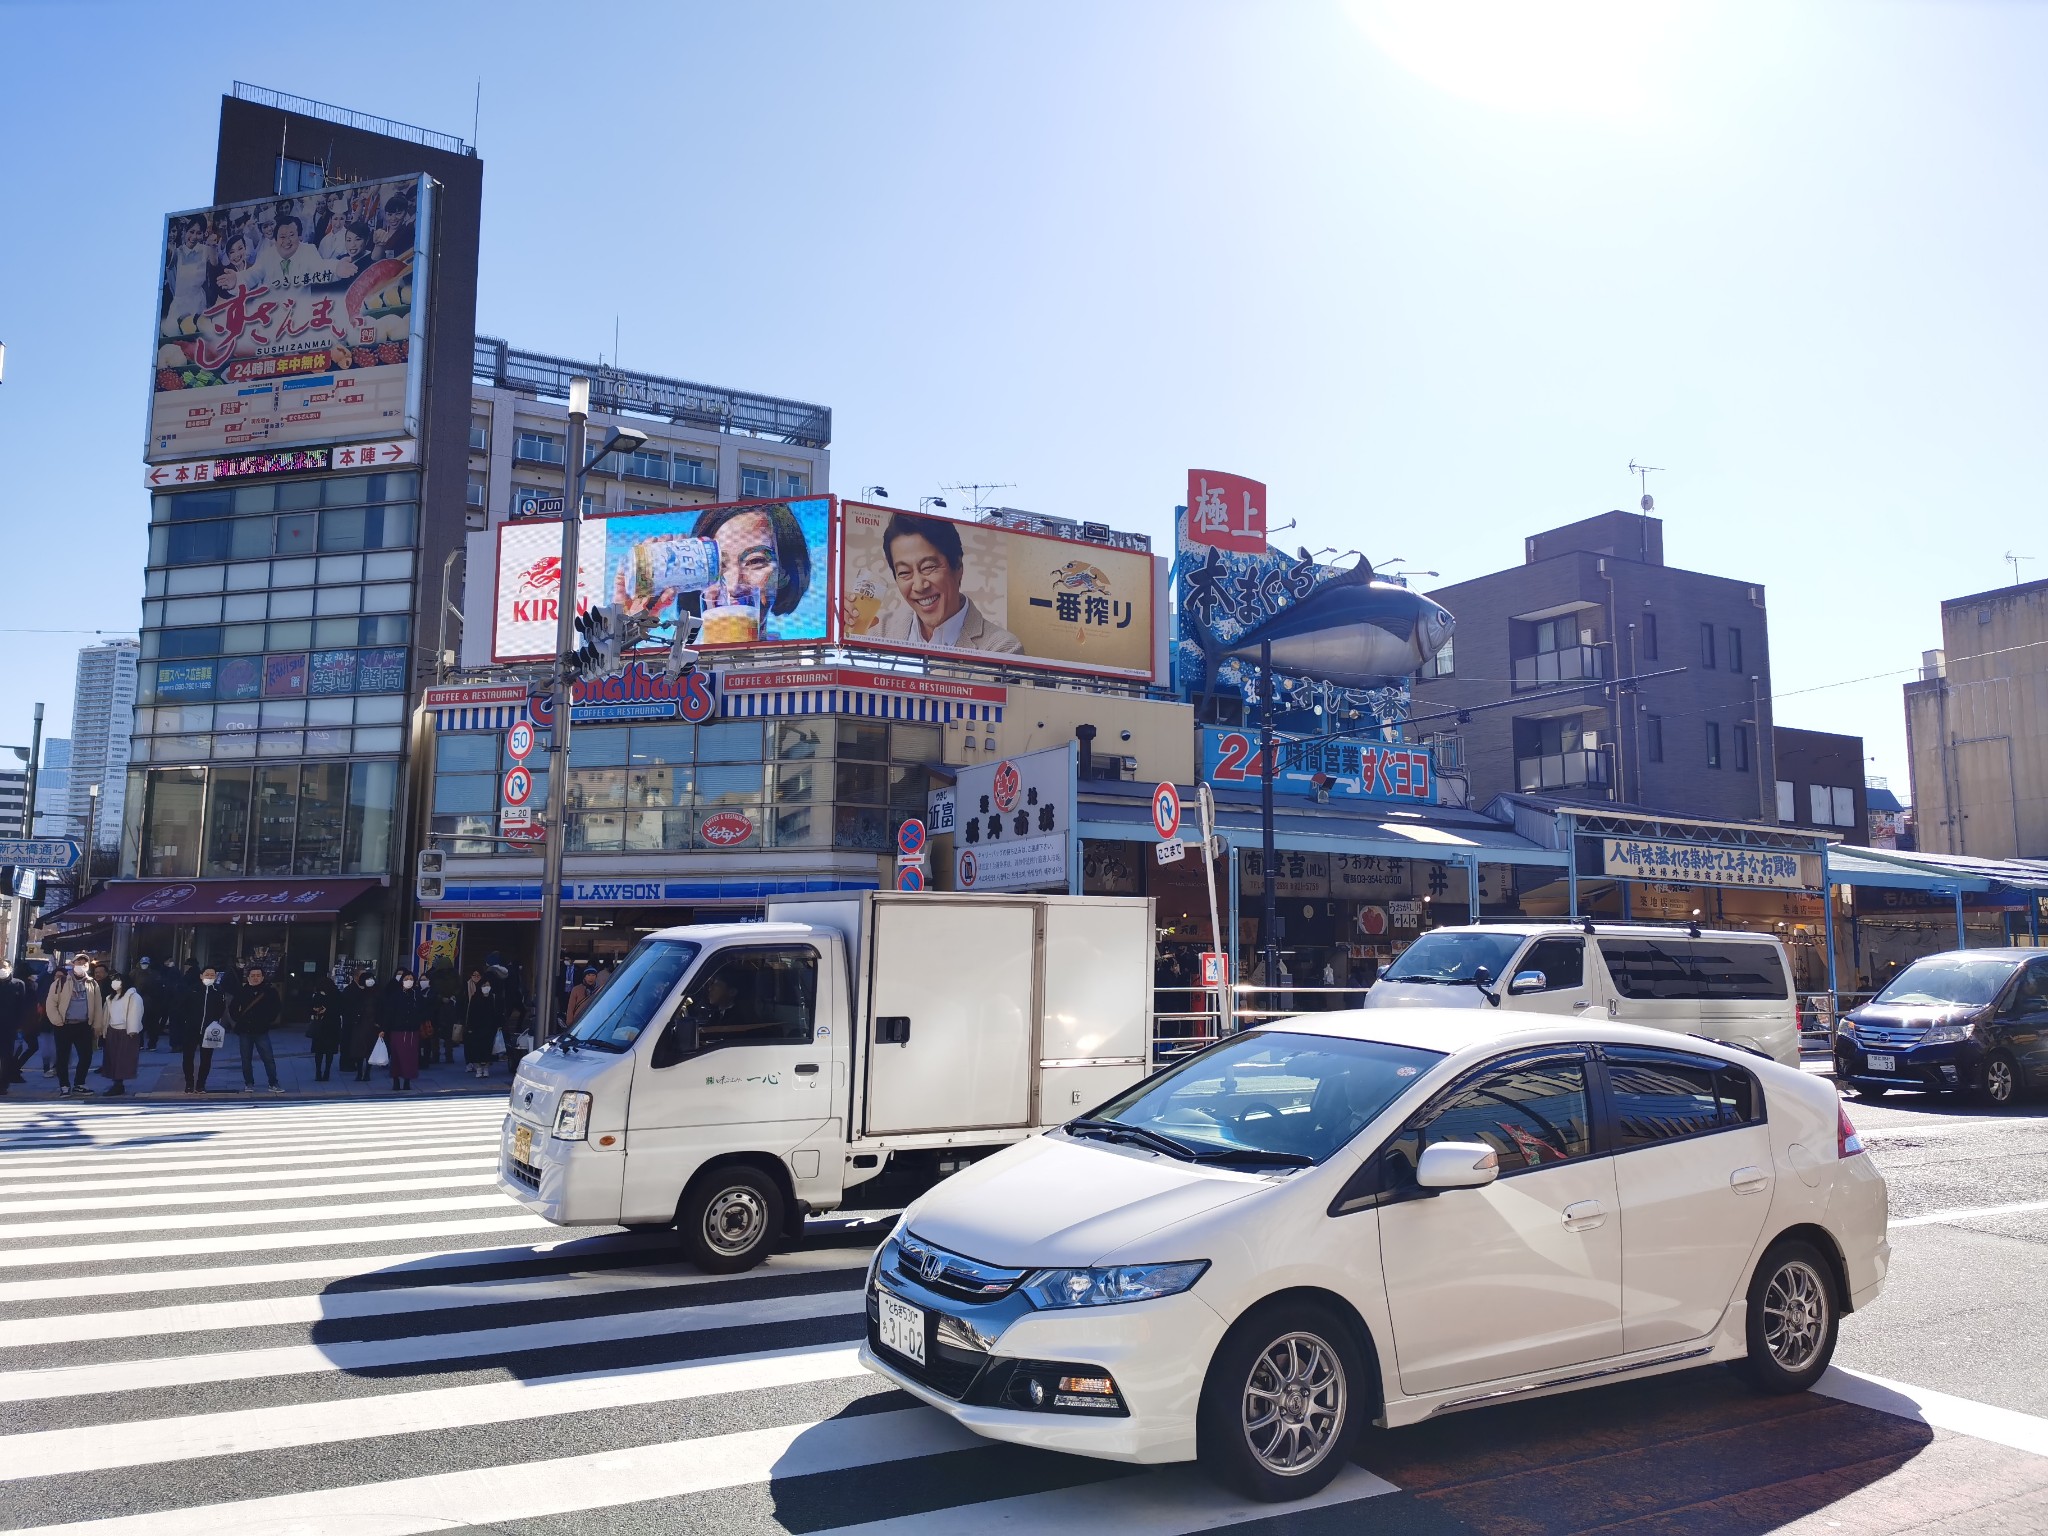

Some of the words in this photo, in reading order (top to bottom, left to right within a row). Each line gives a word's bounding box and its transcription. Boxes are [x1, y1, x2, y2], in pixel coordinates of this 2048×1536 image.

[272, 270, 332, 287] つきじ喜代村
[257, 340, 332, 355] SUSHIZANMAI
[234, 354, 326, 377] 24時間年中無休
[339, 447, 377, 467] 本陣
[175, 464, 208, 482] 本店
[1193, 478, 1264, 539] 極上
[855, 516, 880, 526] KIRIN
[1184, 545, 1317, 627] 本まぐろ
[513, 596, 588, 622] KIRN
[1029, 592, 1131, 628] 一番搾り
[312, 668, 352, 692] 築地
[360, 665, 403, 689] 蟹商
[728, 675, 761, 686] COFFEE
[764, 675, 772, 685] &
[775, 672, 833, 685] RESTAURANT
[873, 676, 906, 689] COFFEE
[909, 680, 916, 690] &
[919, 681, 974, 696] RESTAURANT
[430, 692, 460, 702] COFFEE
[462, 693, 469, 701] &
[472, 689, 523, 700] RESTAURANT
[578, 708, 606, 717] COFFEE
[608, 708, 614, 716] &
[617, 706, 666, 716] RESTAURANT
[513, 731, 528, 749] 50
[936, 790, 948, 801] つきじ
[928, 802, 954, 829] 近富
[0, 843, 65, 856] 新大橋通り
[1158, 843, 1182, 860] ここまで
[52, 856, 67, 864] Ave.
[1611, 842, 1797, 878] 人情味溢れる築地で上手なお買物
[578, 884, 660, 900] LAWSON
[889, 1317, 924, 1360] 31-02
